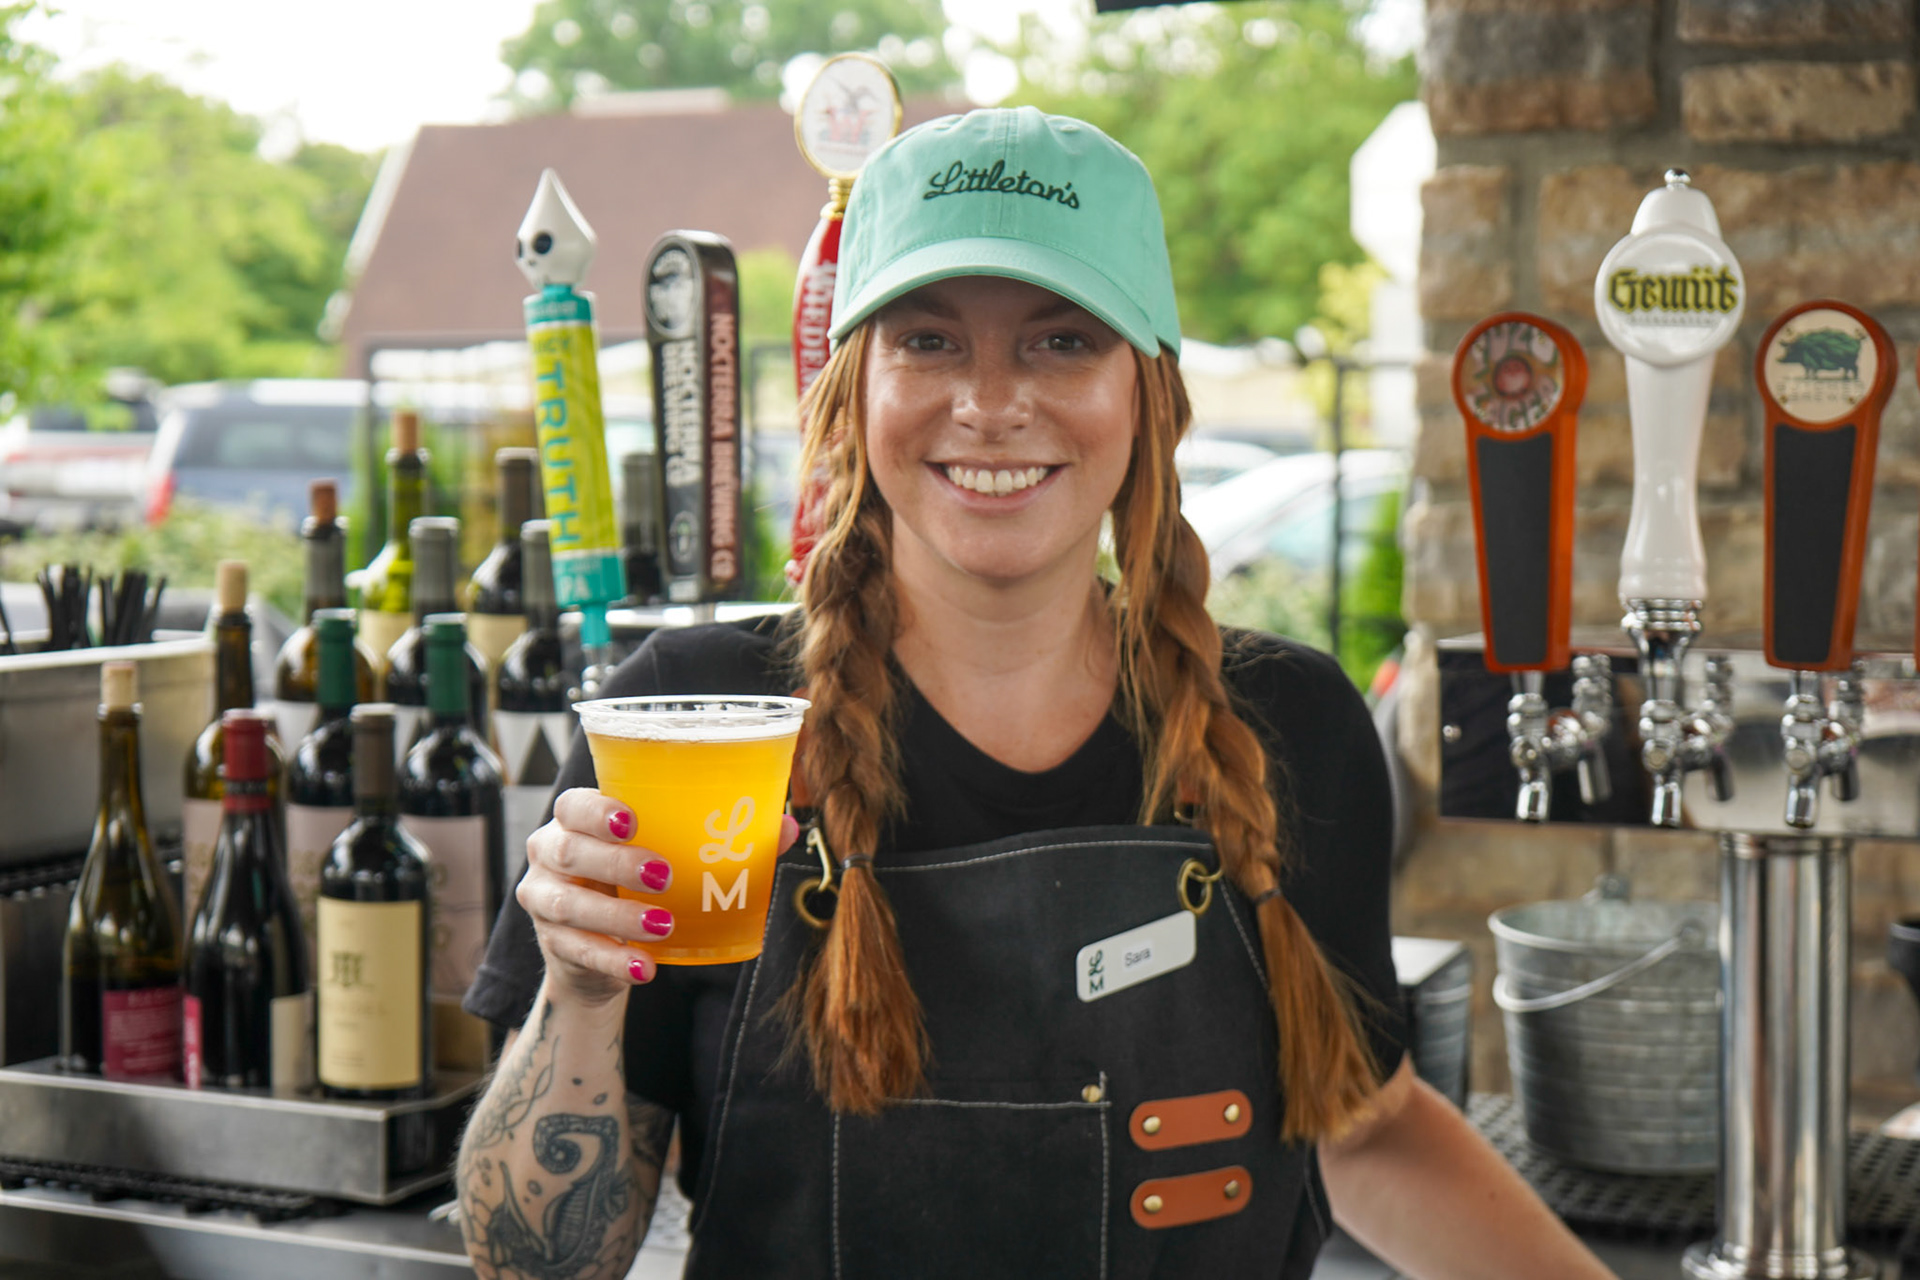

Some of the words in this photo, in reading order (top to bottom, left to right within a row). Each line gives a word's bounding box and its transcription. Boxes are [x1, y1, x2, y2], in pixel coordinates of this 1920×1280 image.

[923, 159, 1080, 209] Littleton's
[679, 340, 702, 485] NOCTERRA
[711, 313, 735, 438] NOCTERRA
[537, 361, 581, 544] TRUTH
[711, 441, 740, 547] BREWING
[702, 868, 749, 912] M
[1124, 947, 1151, 968] Sara
